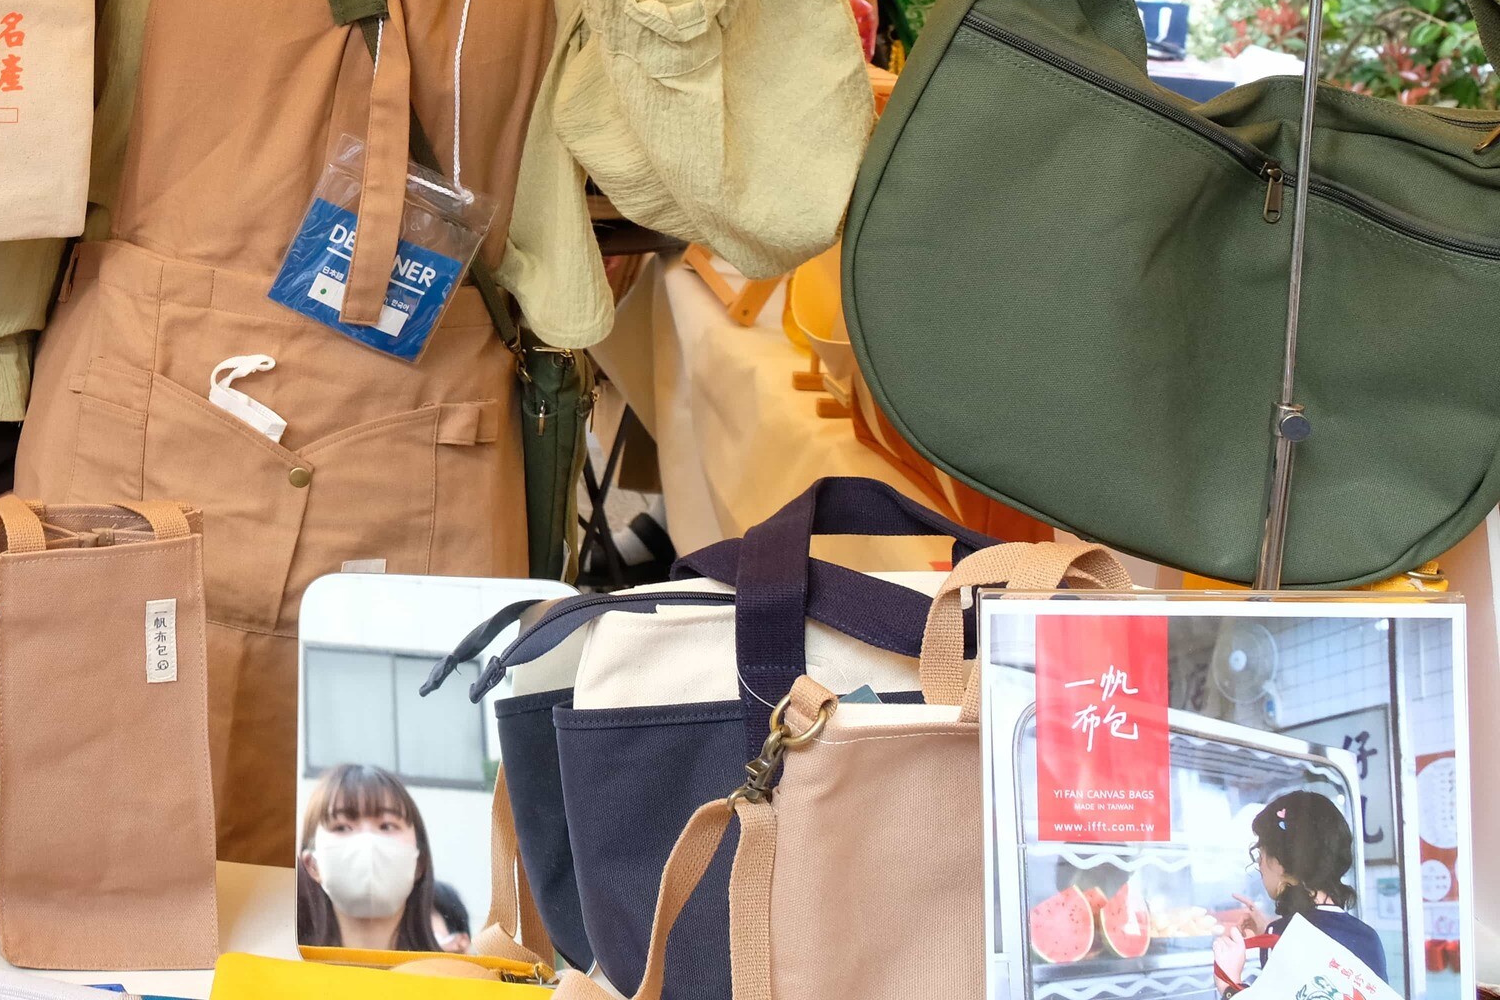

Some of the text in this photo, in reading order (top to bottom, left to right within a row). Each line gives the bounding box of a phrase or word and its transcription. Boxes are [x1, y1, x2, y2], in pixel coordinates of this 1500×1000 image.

[329, 223, 437, 288] DENER
[154, 610, 168, 656] 一帆布包
[1064, 665, 1139, 702] 一帆
[1071, 704, 1139, 752] 布包
[1064, 790, 1084, 799] FAN
[1087, 790, 1125, 799] CANVAS
[1129, 790, 1155, 799] BAGS
[1074, 803, 1095, 811] MADE
[1107, 803, 1134, 811] TAIWAN
[1053, 822, 1155, 832] www.ifft.com.tw
